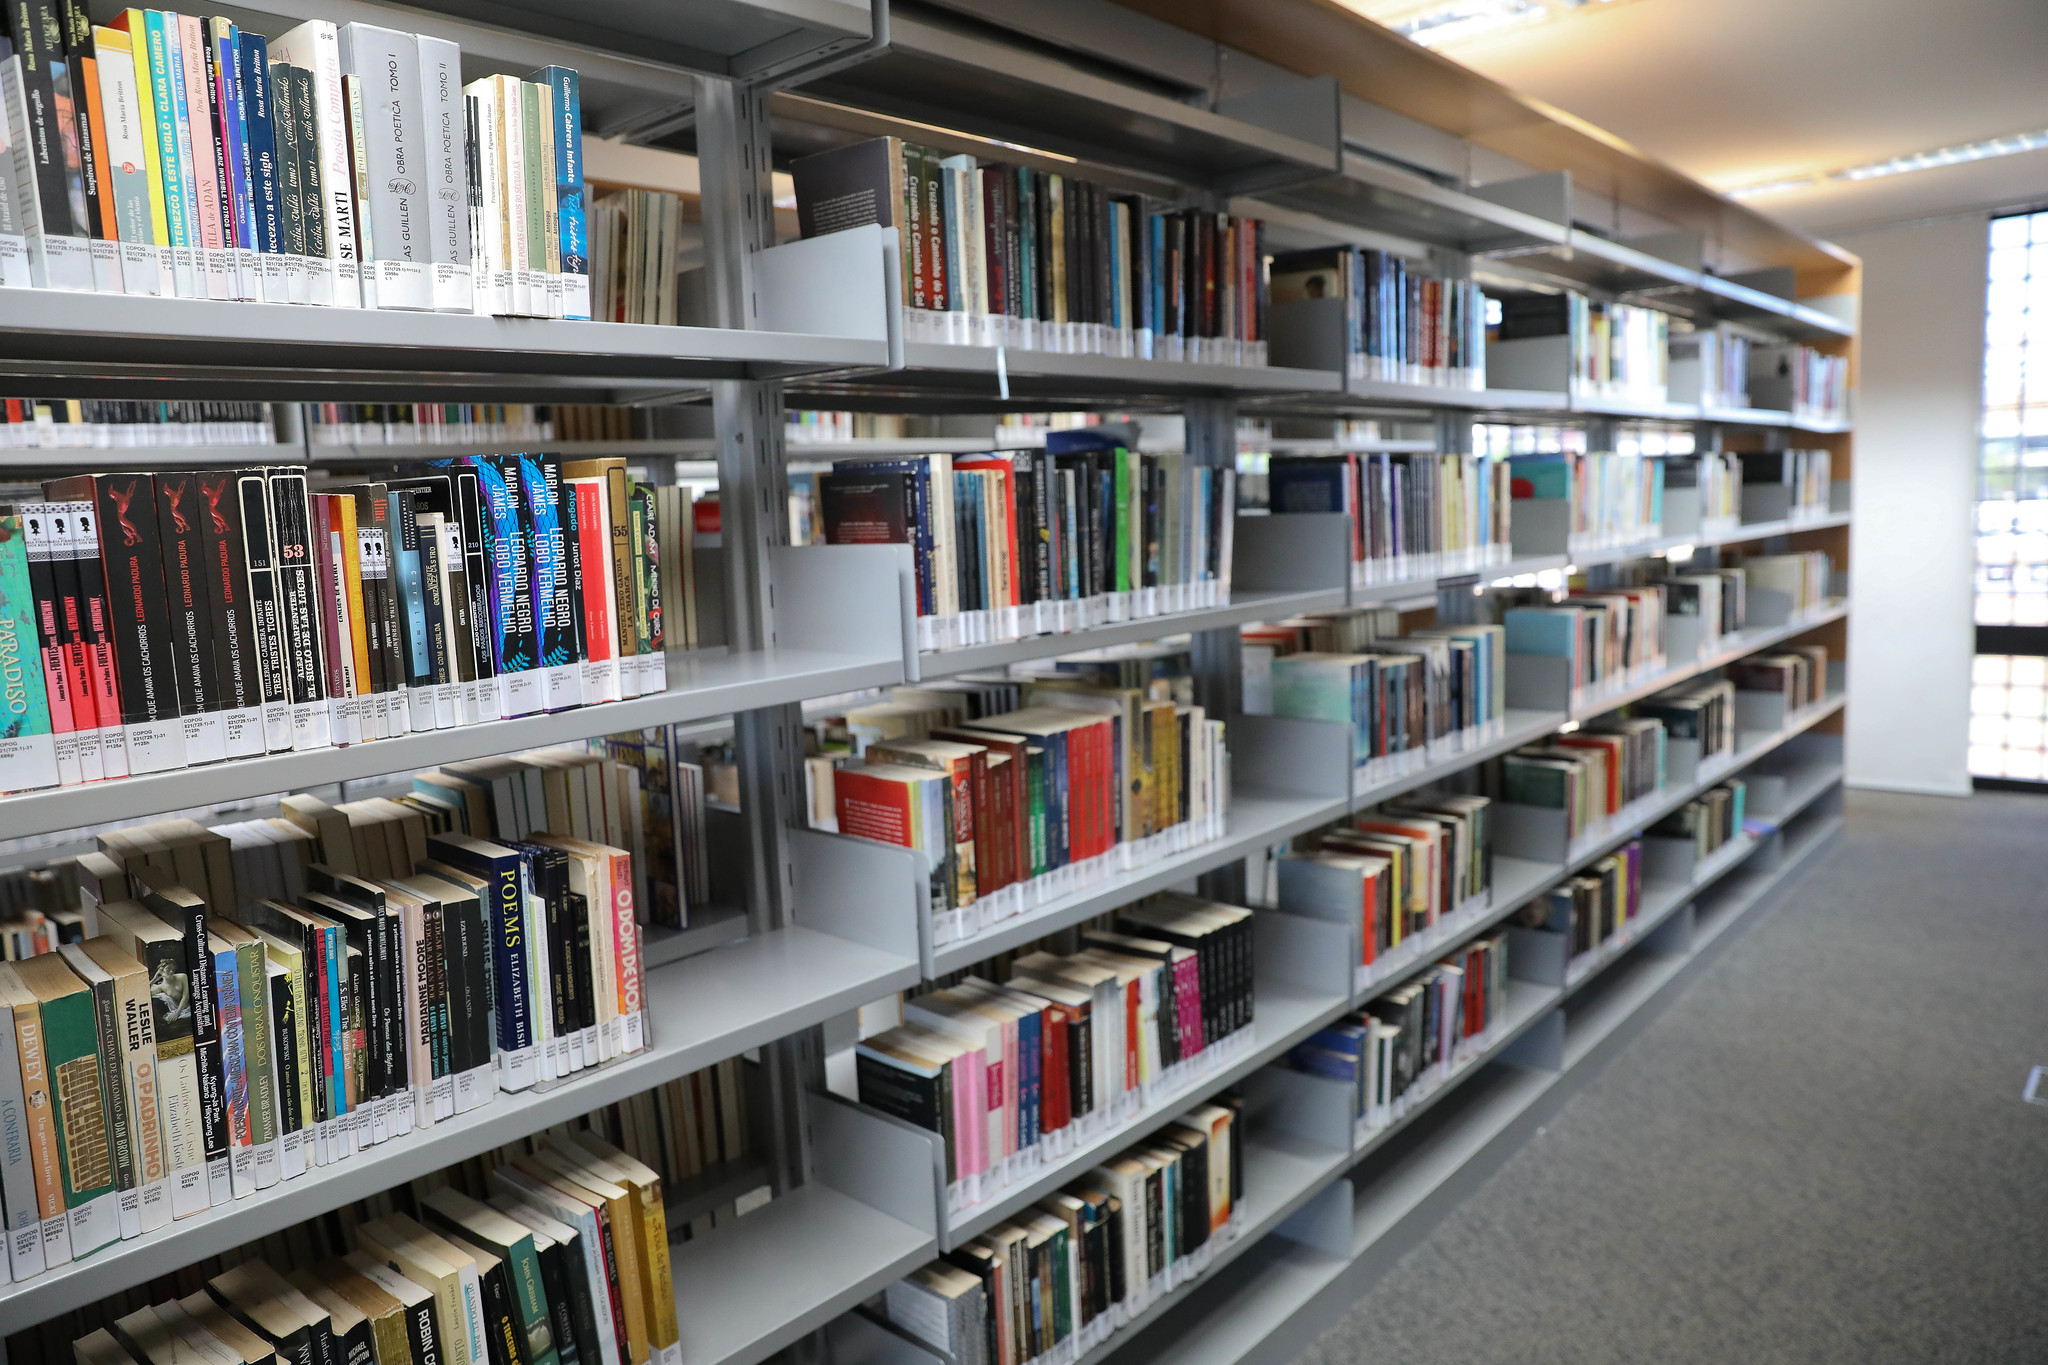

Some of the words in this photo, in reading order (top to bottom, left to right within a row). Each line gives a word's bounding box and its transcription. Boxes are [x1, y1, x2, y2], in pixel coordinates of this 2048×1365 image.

[152, 30, 165, 75] CAMERO
[253, 49, 261, 75] Britton
[439, 63, 447, 71] II
[255, 76, 263, 98] María
[388, 60, 399, 92] TOMO
[440, 74, 449, 103] TOMO
[158, 78, 170, 111] CLARA
[258, 100, 266, 118] Rosa
[563, 76, 571, 111] Guillermo
[81, 113, 91, 151] fantasmas
[391, 100, 403, 142] POETICA
[442, 112, 451, 153] POETICA
[565, 112, 573, 148] Cabrera
[163, 123, 174, 153] SIGLO
[242, 142, 250, 165] CARAS
[82, 152, 91, 161] de
[166, 156, 177, 182] ESTE
[260, 152, 273, 178] siglo
[395, 146, 405, 174] OBRA
[444, 156, 453, 184] OBRA
[567, 150, 575, 183] Infante
[85, 164, 97, 195] Suspiros
[169, 184, 178, 193] A
[218, 168, 227, 198] INVISIBLE
[263, 180, 274, 202] este
[335, 192, 351, 237] MARTI
[400, 198, 411, 241] GUILLEN
[447, 204, 457, 246] GUILLEN
[569, 216, 581, 253] tristes
[340, 243, 353, 259] SE
[504, 467, 519, 509] MARLON
[532, 481, 547, 515] JAMES
[544, 464, 559, 505] MARLON
[491, 484, 506, 519] JAMES
[568, 490, 578, 531] Afogado
[646, 494, 655, 521] CLAIRE
[613, 525, 629, 536] 55
[647, 523, 656, 554] ADAM
[178, 540, 188, 568] PADURA
[283, 544, 305, 559] 53
[494, 537, 510, 568] LOBO
[510, 532, 527, 591] LEOPARDO
[534, 533, 550, 563] LOBO
[549, 527, 568, 585] LEOPARDO
[129, 556, 140, 584] PADURA
[650, 564, 659, 597] MENINO
[181, 570, 193, 607] LEONARDO
[295, 569, 306, 604] LUCES
[537, 567, 556, 628] VERMELHO
[618, 590, 626, 610] ZENO
[624, 575, 632, 613] CHARCA
[40, 600, 56, 635] HEMINGWAY
[132, 585, 145, 622] LEONARDO
[255, 599, 265, 626] INFANTE
[264, 600, 275, 632] TIGRES
[299, 607, 309, 629] LAS
[498, 572, 516, 633] VERMELHO
[516, 594, 533, 637] NEGRO,
[555, 589, 571, 630] NEGRO,
[185, 611, 197, 653] CACHORROS
[289, 590, 302, 648] CARPENTIER
[620, 612, 628, 646] MANUEL
[627, 616, 633, 628] LA
[653, 612, 661, 637] OURO
[137, 624, 151, 666] CACHORROS
[258, 628, 268, 658] CABRERA
[268, 635, 279, 670] TRISTES
[302, 631, 311, 646] DE
[0, 619, 27, 714] PARADISO
[48, 646, 61, 671] FUENTES
[142, 667, 152, 676] OS
[190, 654, 199, 663] OS
[296, 650, 305, 678] ALEJO
[304, 649, 314, 682] SIGLO
[143, 676, 155, 699] AMAVA
[192, 664, 203, 687] AMAVA
[262, 659, 272, 697] GUILLERMO
[272, 673, 282, 695] TRES
[307, 683, 316, 699] EL
[146, 700, 157, 714] QUE
[194, 688, 205, 703] QUE
[500, 869, 520, 948] POEMS
[617, 889, 632, 907] O
[618, 910, 637, 954] DOM
[200, 960, 208, 984] Distance
[416, 938, 426, 982] MOORE
[622, 954, 638, 977] DE
[192, 968, 201, 1000] Language
[202, 985, 211, 1014] Learning
[510, 953, 524, 1018] ELIZABETH
[125, 998, 140, 1051] WALLER
[138, 1002, 152, 1045] LESLIE
[195, 1000, 204, 1035] Acquisition
[204, 1015, 212, 1027] and
[418, 984, 429, 1046] MARIANNE
[21, 1023, 43, 1083] DEWEY
[200, 1047, 208, 1073] Michiko
[344, 1052, 352, 1069] Land
[136, 1063, 152, 1077] O
[38, 1116, 47, 1130] Um
[140, 1082, 161, 1179] PADRINHO
[42, 1146, 52, 1165] entre
[118, 1139, 129, 1168] BROWN
[521, 1257, 532, 1279] JOHN
[418, 1308, 433, 1353] ROBIN
